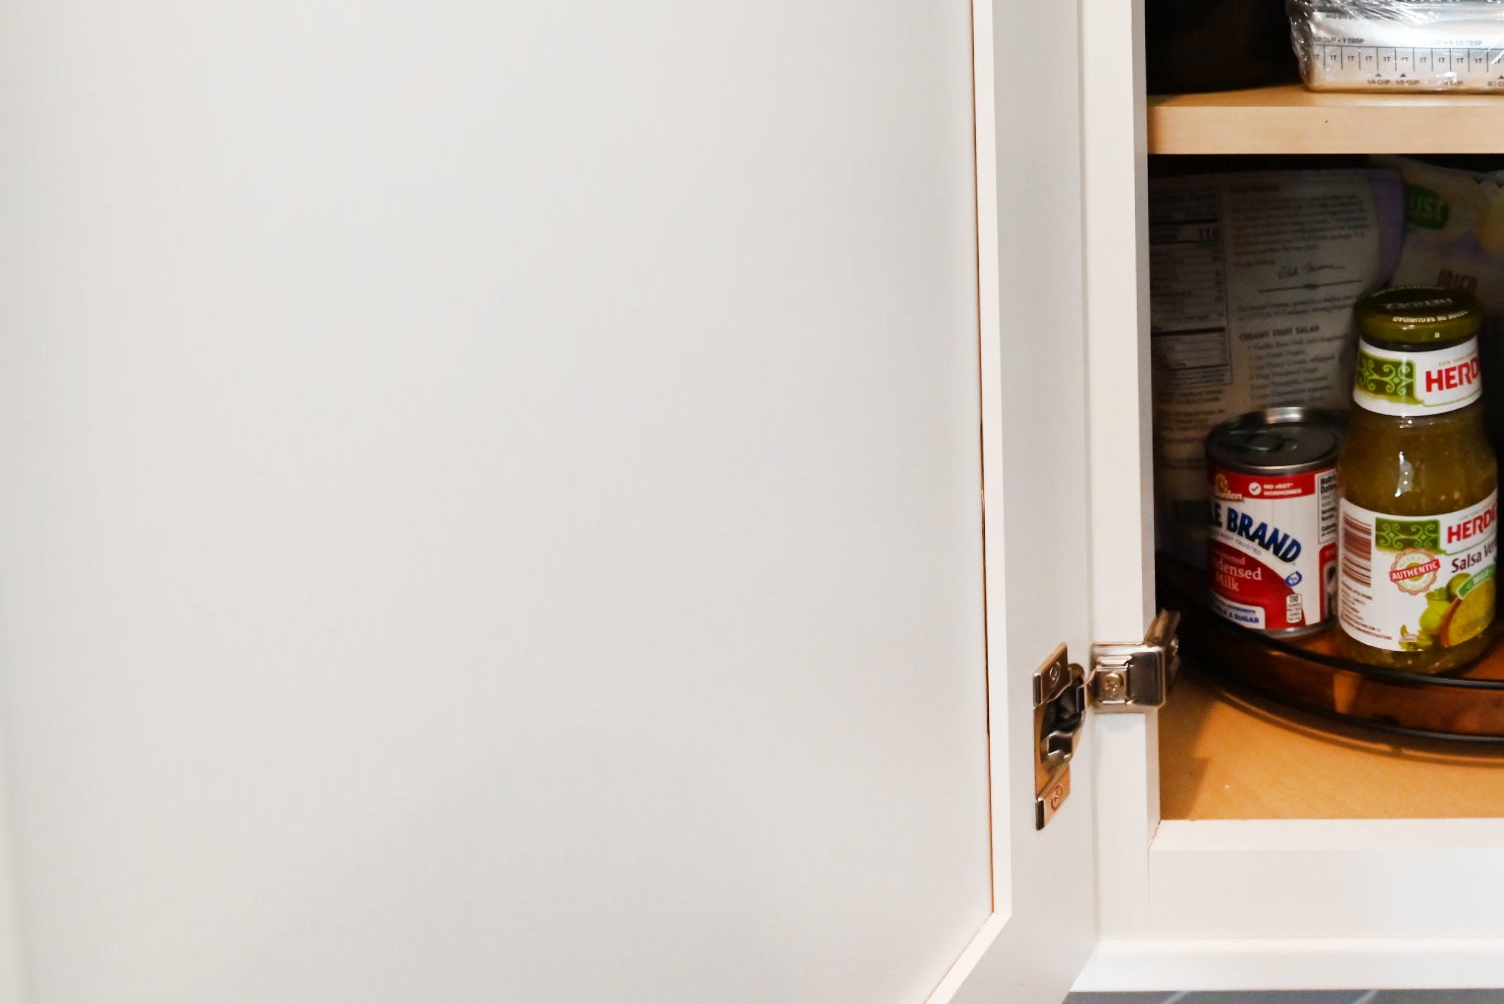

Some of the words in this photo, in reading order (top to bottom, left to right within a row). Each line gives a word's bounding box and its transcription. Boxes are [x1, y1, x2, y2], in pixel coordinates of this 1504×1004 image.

[1425, 356, 1479, 393] HERD
[1226, 506, 1302, 563] BRAND
[1392, 560, 1438, 581] AUTHENTIC
[1451, 551, 1482, 573] Salsa
